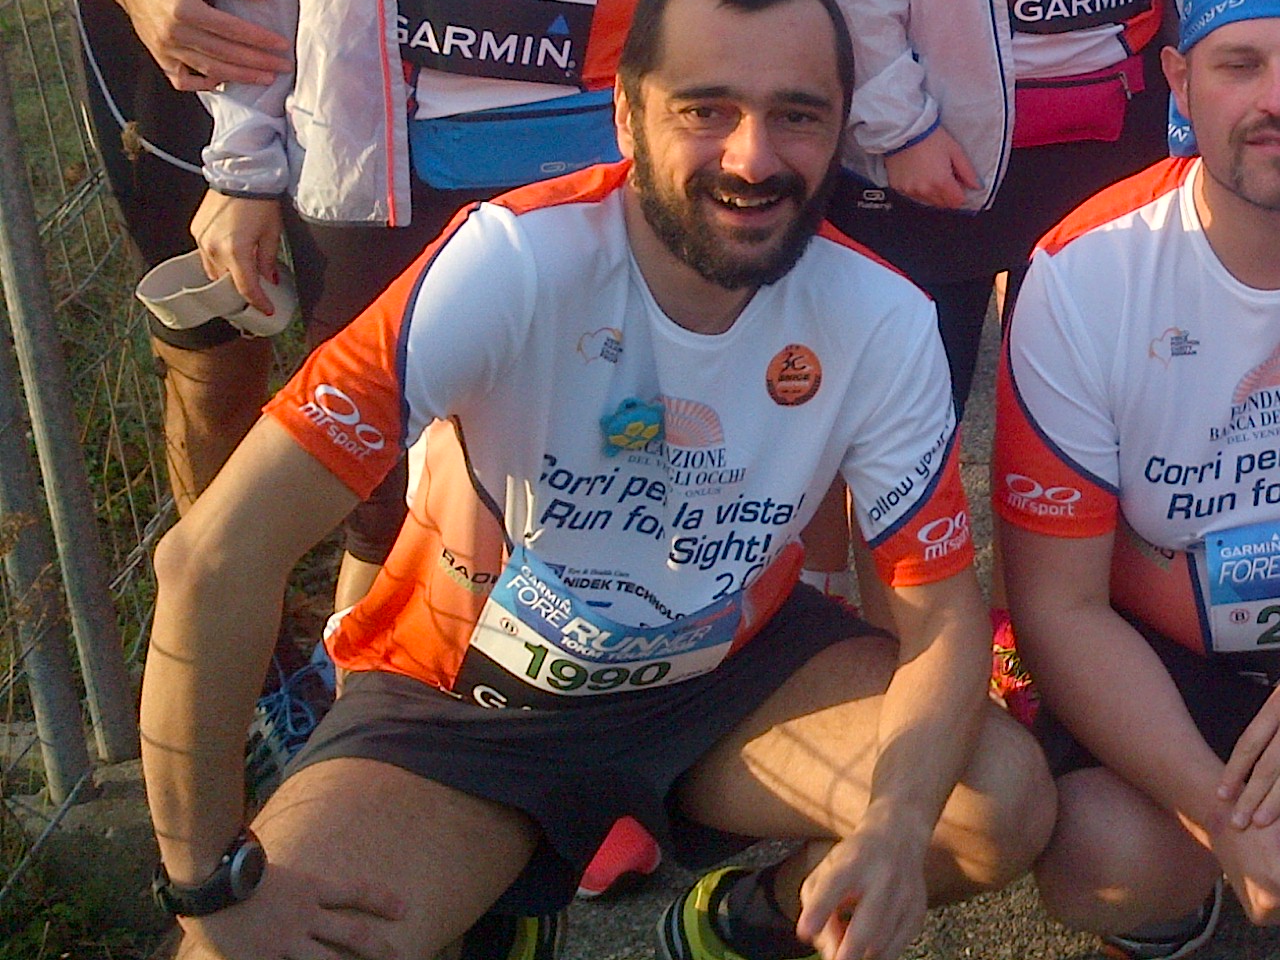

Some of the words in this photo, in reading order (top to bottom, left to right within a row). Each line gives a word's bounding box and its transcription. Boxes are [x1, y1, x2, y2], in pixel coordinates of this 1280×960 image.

[696, 467, 747, 486] OCCHI
[1144, 451, 1222, 486] Corri
[672, 501, 703, 530] la
[715, 493, 806, 526] vista!
[1167, 491, 1236, 520] Run
[540, 498, 612, 530] Run
[669, 530, 772, 571] Sight!
[521, 565, 572, 615] GARMIN
[563, 577, 612, 590] NIDEK
[523, 641, 672, 691] 1990
